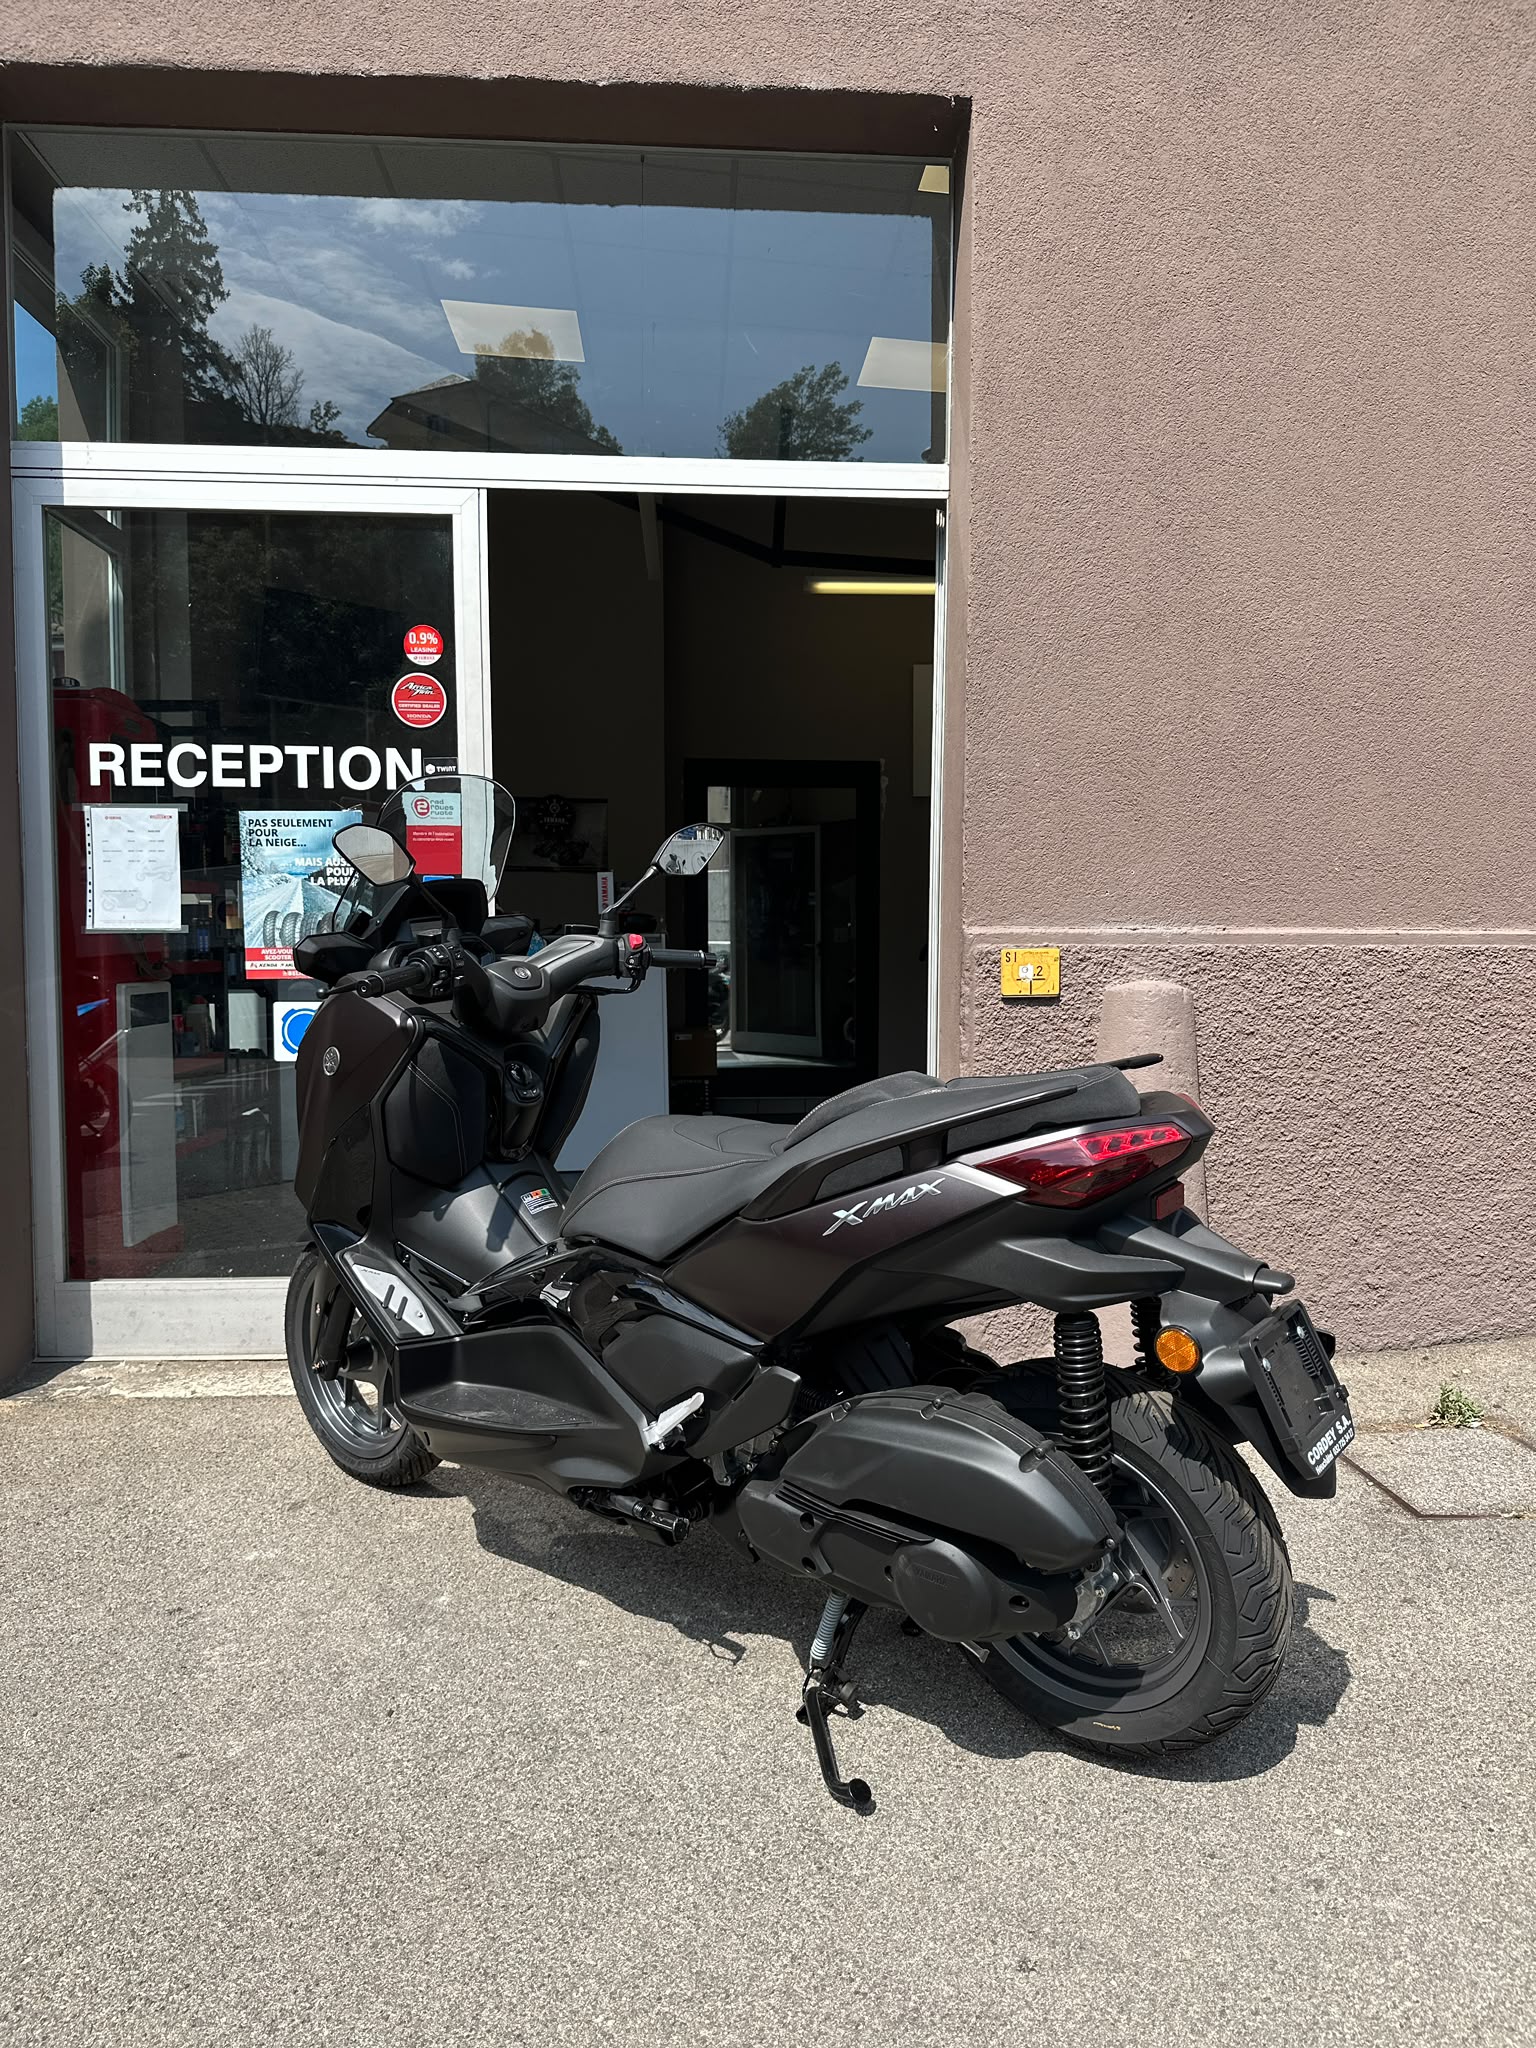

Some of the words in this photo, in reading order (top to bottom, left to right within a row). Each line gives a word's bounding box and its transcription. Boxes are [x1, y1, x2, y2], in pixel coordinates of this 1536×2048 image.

[408, 632, 438, 645] 0.9%
[401, 682, 433, 691] Africa
[411, 689, 435, 697] Twin
[89, 742, 424, 791] RECEPTION
[248, 819, 268, 828] PAS
[270, 819, 333, 828] SEULEMENT
[248, 829, 278, 838] POUR
[248, 838, 263, 848] LA
[265, 838, 307, 848] NEIGE...
[294, 857, 322, 867] MAIS
[310, 876, 326, 886] LA
[601, 876, 609, 902] YAMAHA
[1307, 1427, 1337, 1466] CORDEY
[1335, 1415, 1351, 1435] S.A.
